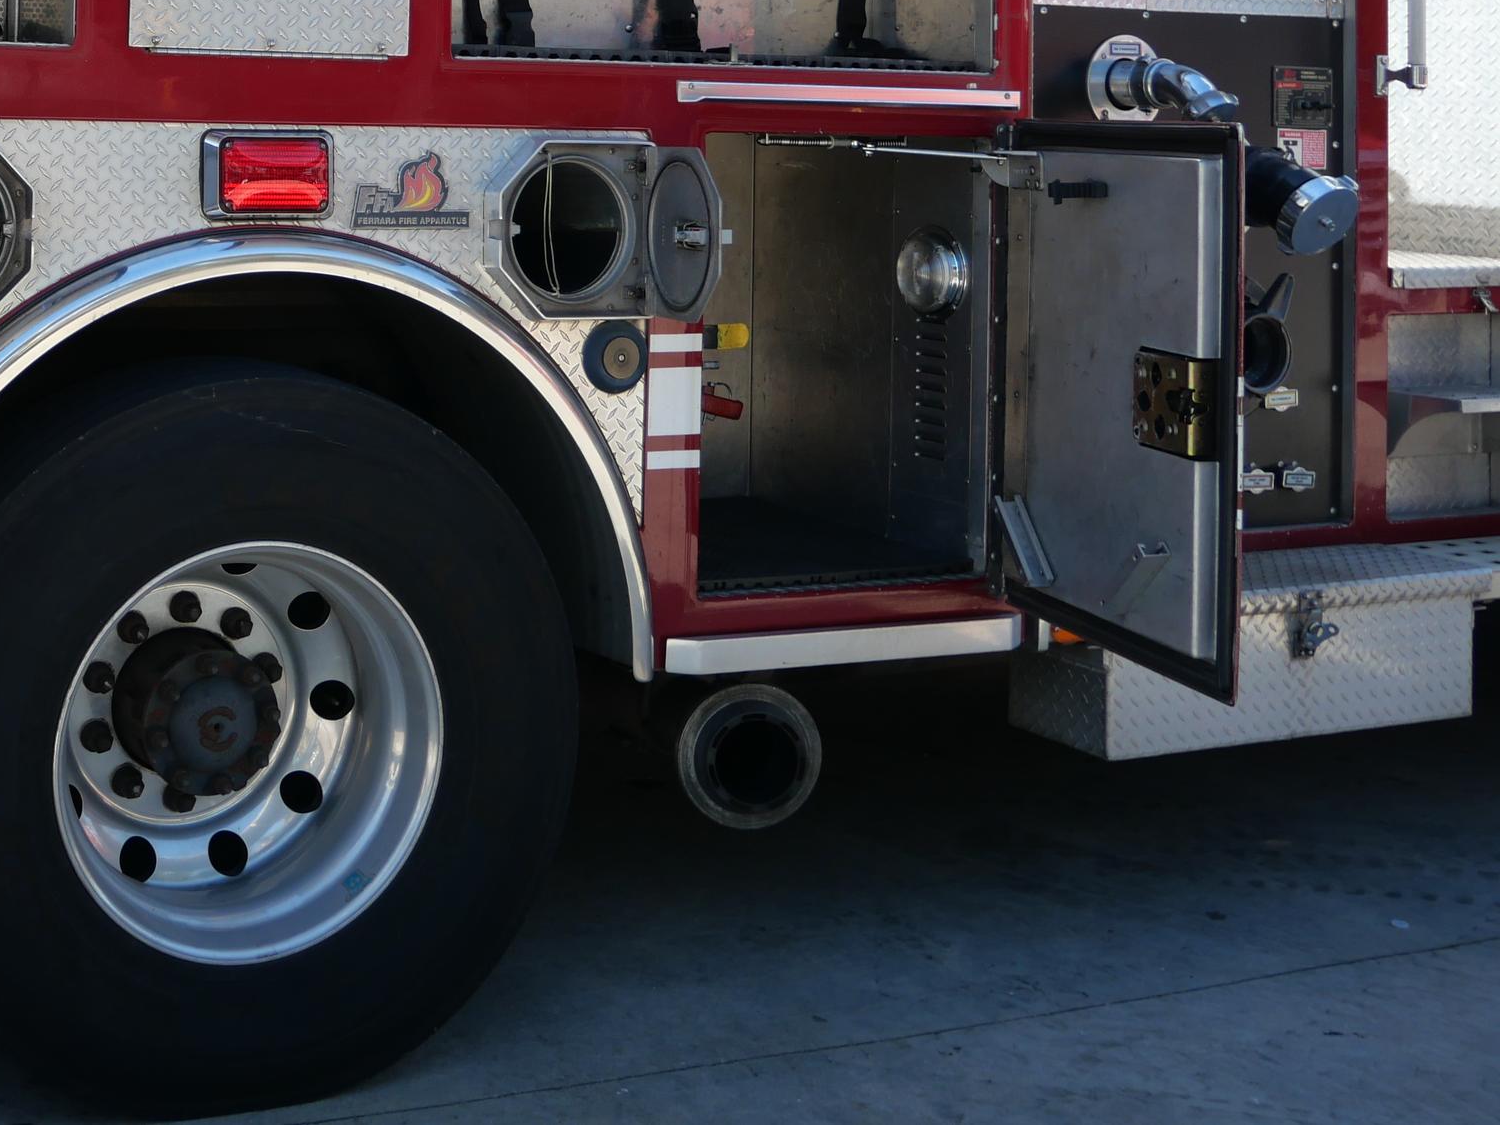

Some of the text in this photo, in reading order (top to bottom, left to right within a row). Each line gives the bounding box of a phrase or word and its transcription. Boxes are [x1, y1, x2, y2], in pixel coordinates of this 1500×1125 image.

[358, 217, 467, 225] FERRARA FIRE APPARATUS
